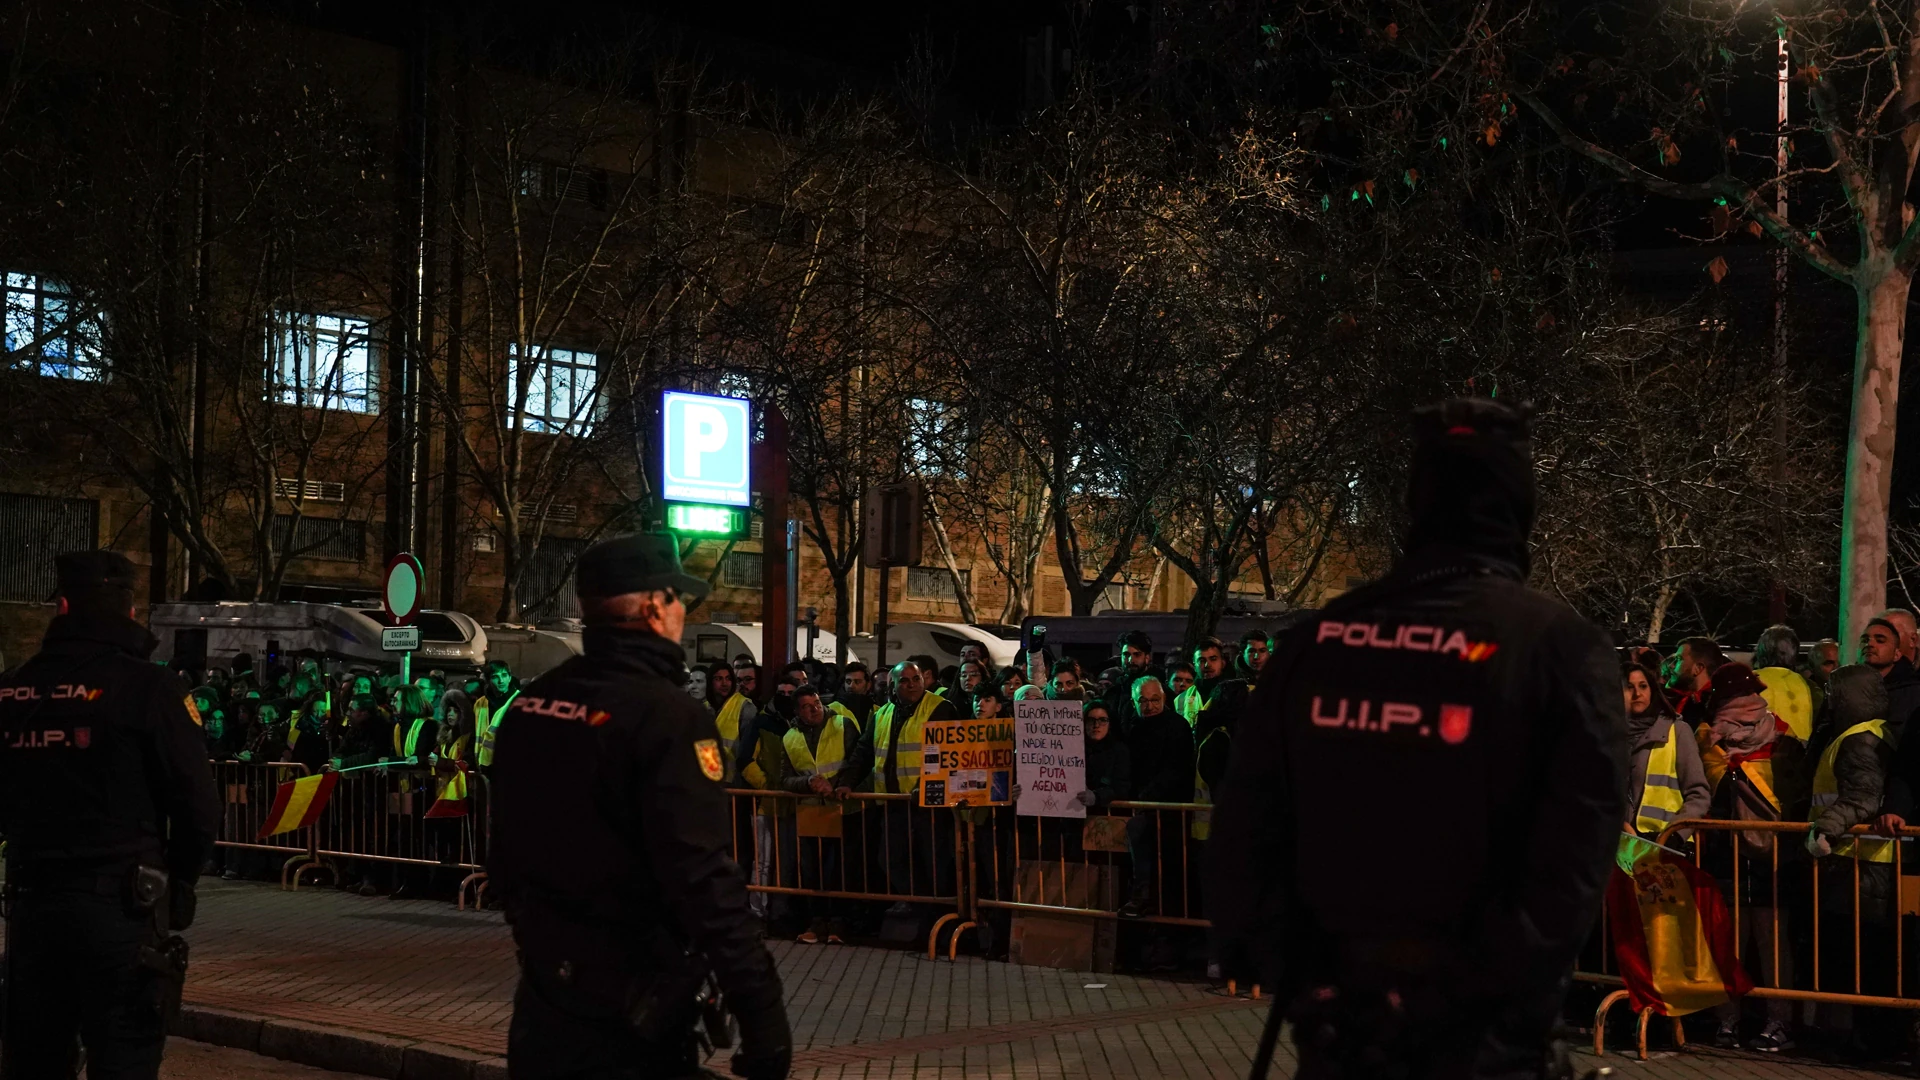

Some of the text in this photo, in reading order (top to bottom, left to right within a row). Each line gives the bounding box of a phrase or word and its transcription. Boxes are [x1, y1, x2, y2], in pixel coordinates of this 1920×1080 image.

[684, 403, 728, 477] P
[391, 631, 410, 639] EXCEPTO
[1315, 620, 1469, 656] POLICIA
[1311, 695, 1432, 737] U.I.P.
[925, 727, 944, 745] NO
[946, 726, 966, 744] ES
[1024, 720, 1082, 736] TÚ OBEDECES
[1050, 739, 1064, 750] HA
[940, 748, 1012, 769] ES SAQUEO
[1039, 766, 1066, 779] PUTA
[1031, 780, 1068, 793] AGENDA
